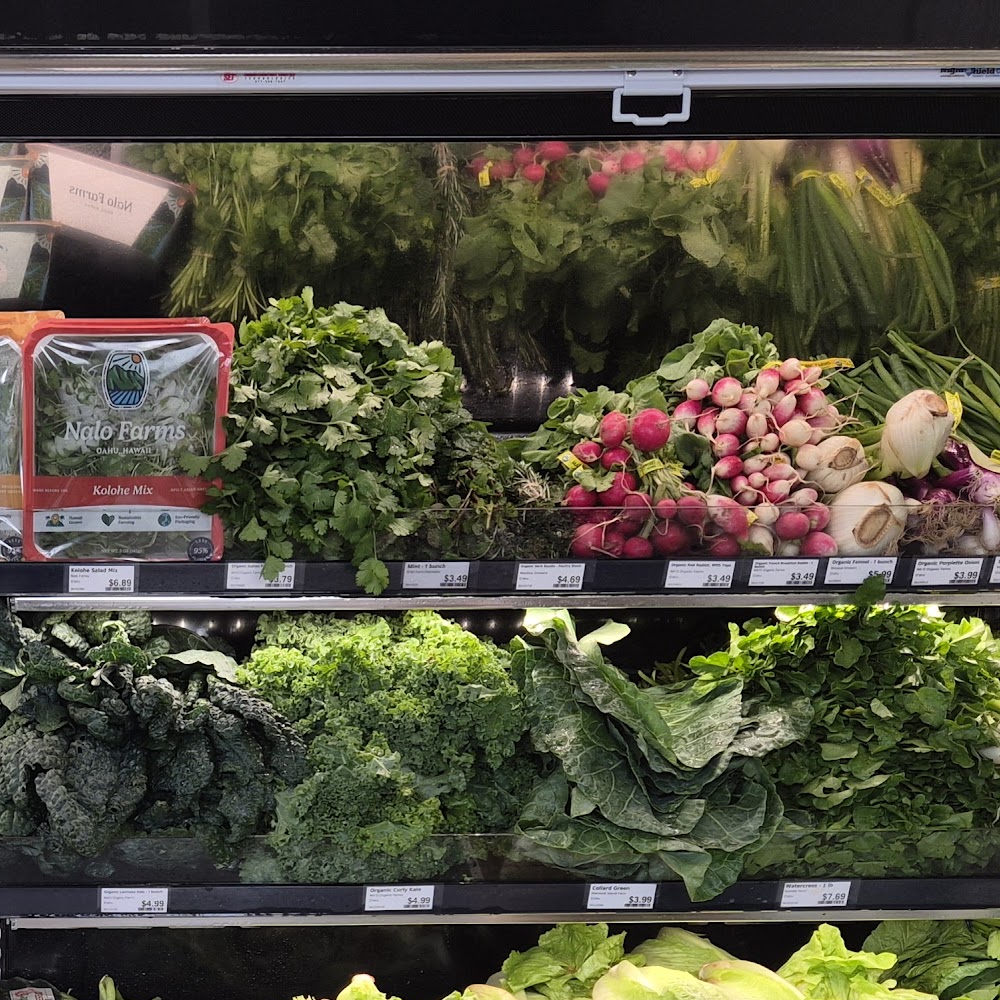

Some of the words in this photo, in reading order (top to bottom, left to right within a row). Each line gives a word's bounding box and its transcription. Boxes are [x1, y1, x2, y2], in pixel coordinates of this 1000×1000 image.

[63, 421, 112, 441] Nalo
[118, 421, 186, 442] Farms
[92, 485, 130, 496] Kolohe
[132, 485, 153, 495] Mix
[444, 575, 468, 583] $3.49
[707, 575, 731, 583] $3.49
[954, 571, 978, 580] $3.99
[108, 580, 132, 588] $6.89
[557, 576, 581, 584] $4.69
[628, 896, 652, 904] $3.99
[822, 892, 846, 901] $7.69
